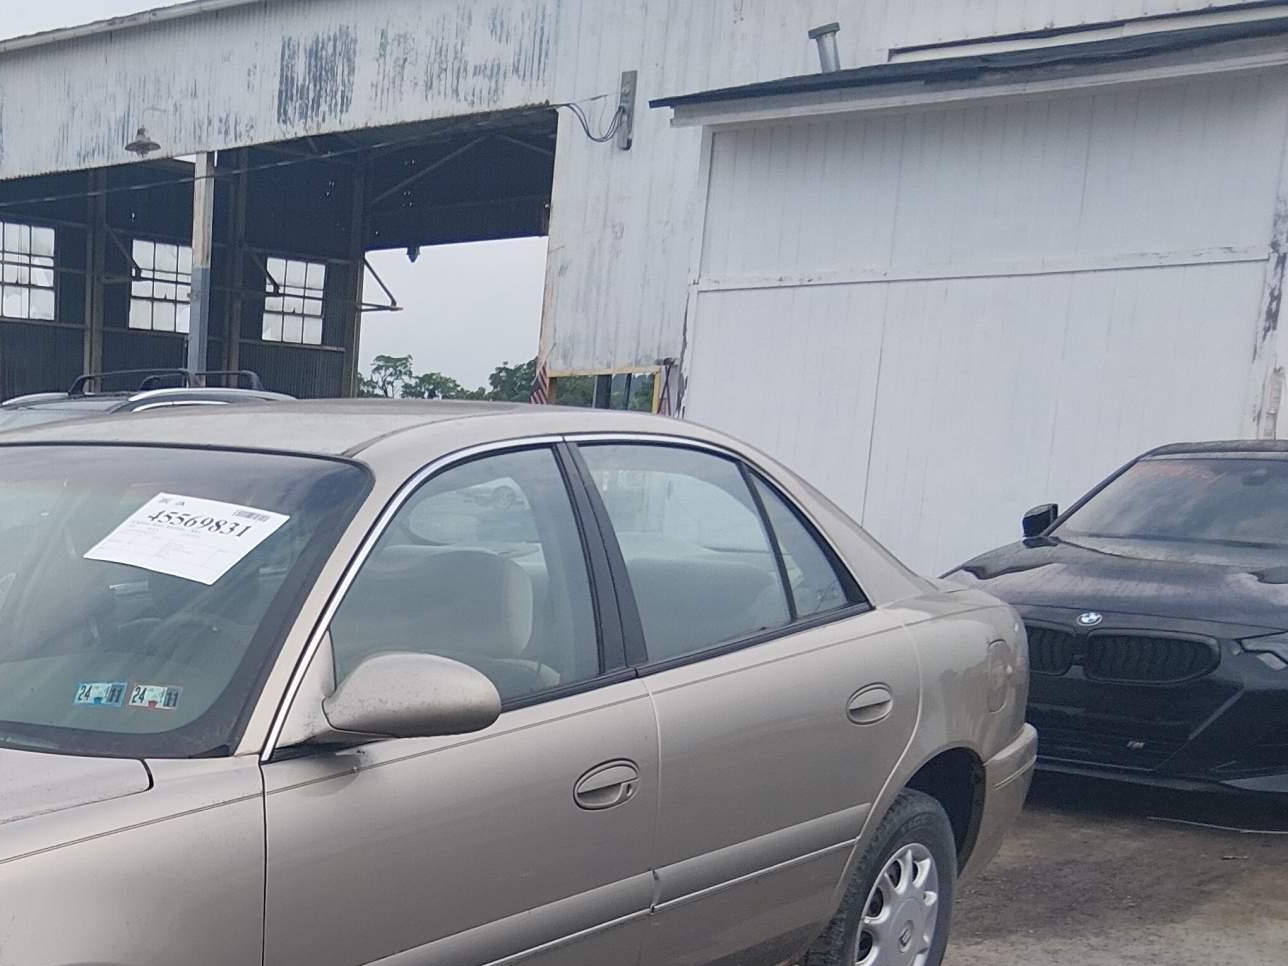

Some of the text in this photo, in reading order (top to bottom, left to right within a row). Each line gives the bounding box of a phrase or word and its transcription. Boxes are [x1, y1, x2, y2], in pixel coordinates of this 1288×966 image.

[148, 508, 252, 538] 45569831
[78, 684, 92, 701] 24
[132, 686, 147, 704] 24
